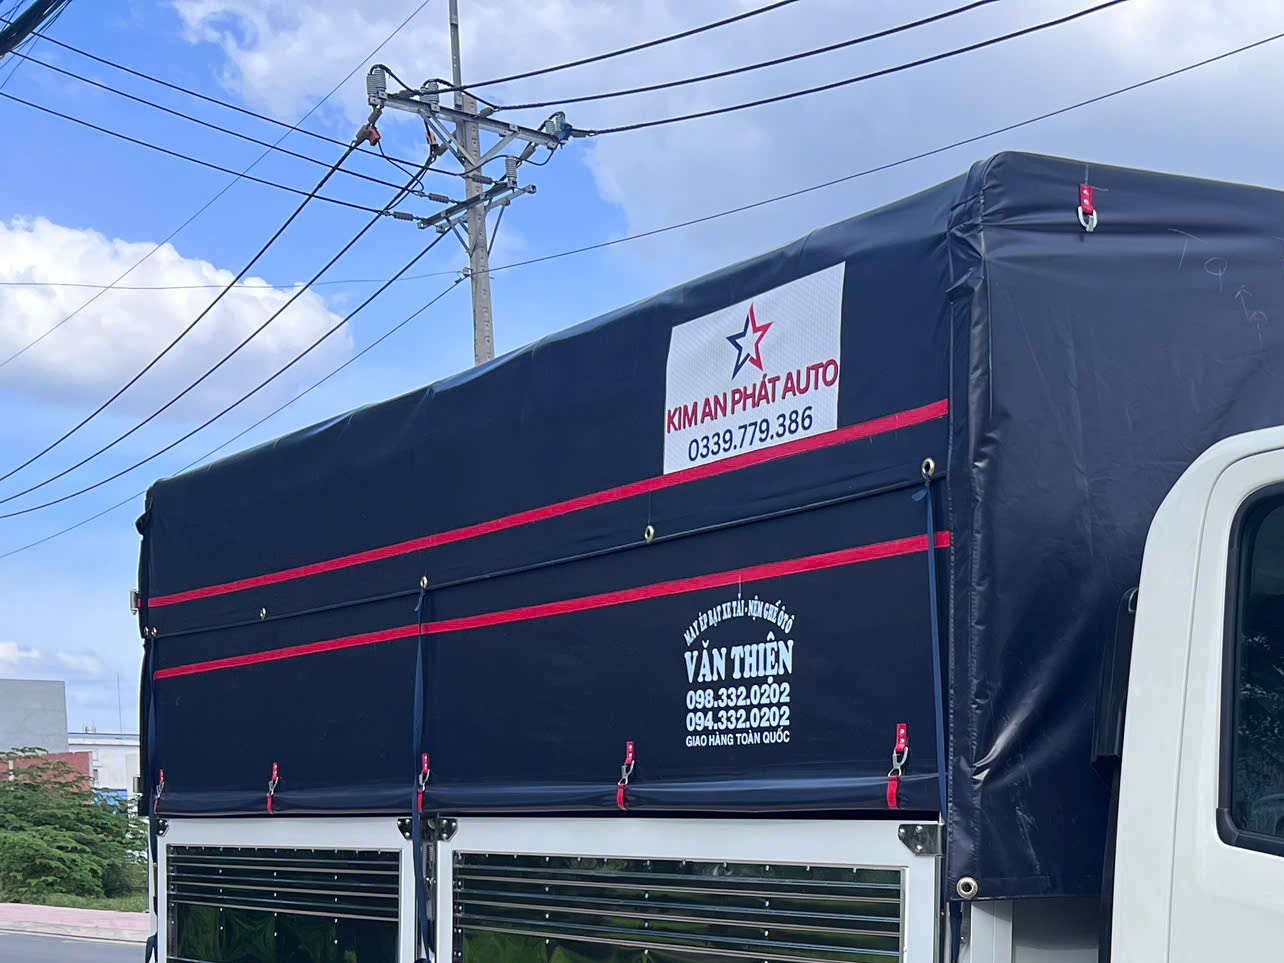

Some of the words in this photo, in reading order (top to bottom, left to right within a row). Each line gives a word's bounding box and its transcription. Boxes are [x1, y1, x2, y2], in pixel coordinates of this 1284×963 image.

[667, 401, 698, 433] KIM
[700, 392, 727, 424] AN
[731, 374, 781, 415] PHÁT
[781, 359, 839, 399] AUTO
[688, 406, 813, 461] 0339.779.386
[721, 602, 732, 620] XE
[684, 639, 727, 683] VĂN
[730, 631, 794, 684] THIỆN
[686, 682, 790, 709] 098.332.0202
[686, 705, 790, 731] 094.332.0202
[685, 735, 707, 747] GIAO
[708, 732, 734, 746] HÀNG
[735, 729, 761, 745] TOÀN
[762, 726, 790, 743] QUỐC
